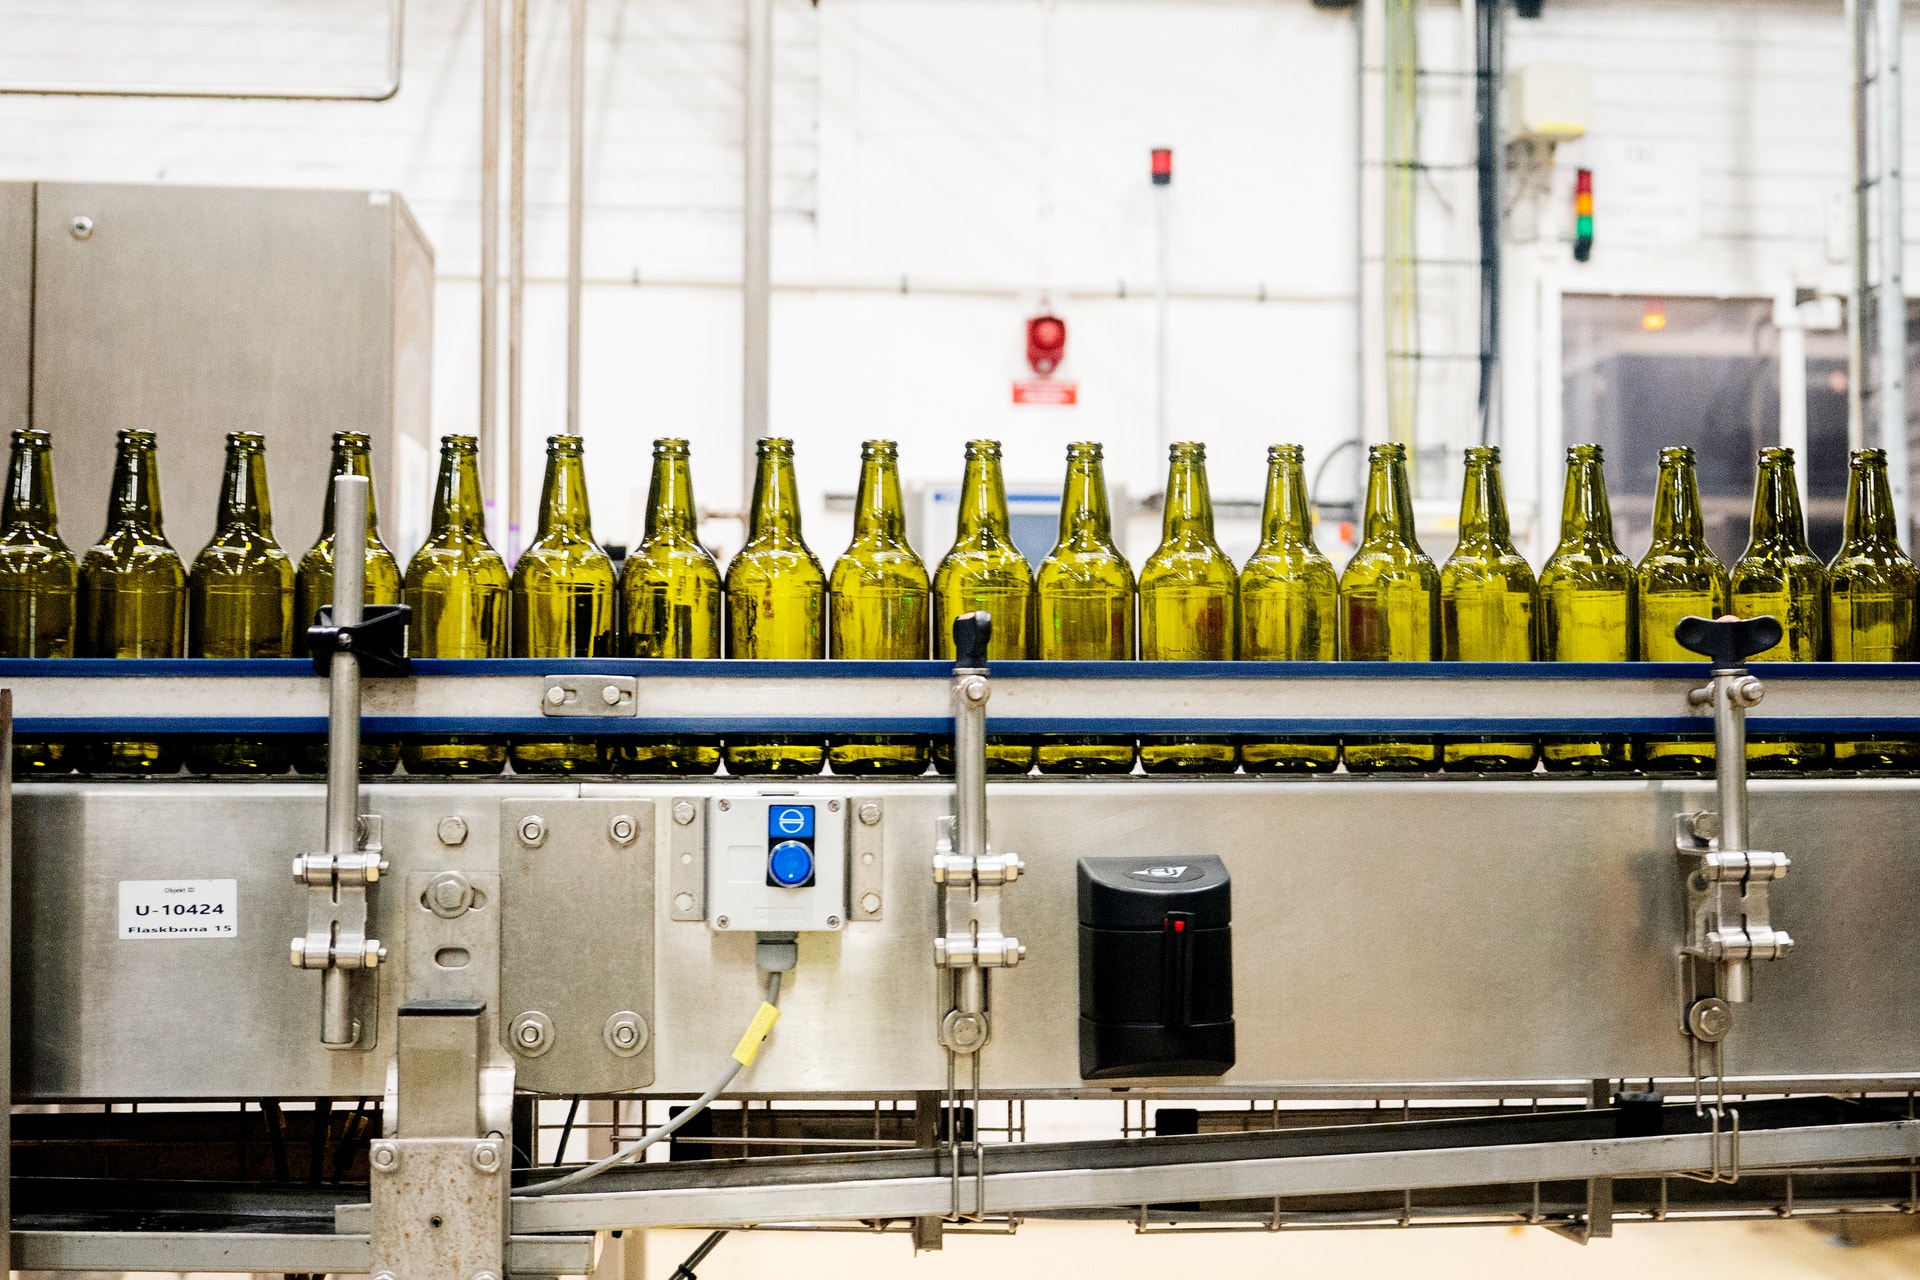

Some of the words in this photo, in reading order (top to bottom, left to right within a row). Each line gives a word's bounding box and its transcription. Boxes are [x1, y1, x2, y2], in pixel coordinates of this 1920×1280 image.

[164, 887, 186, 895] Objekt
[135, 903, 224, 917] U-10424
[128, 926, 208, 934] Flaskbana
